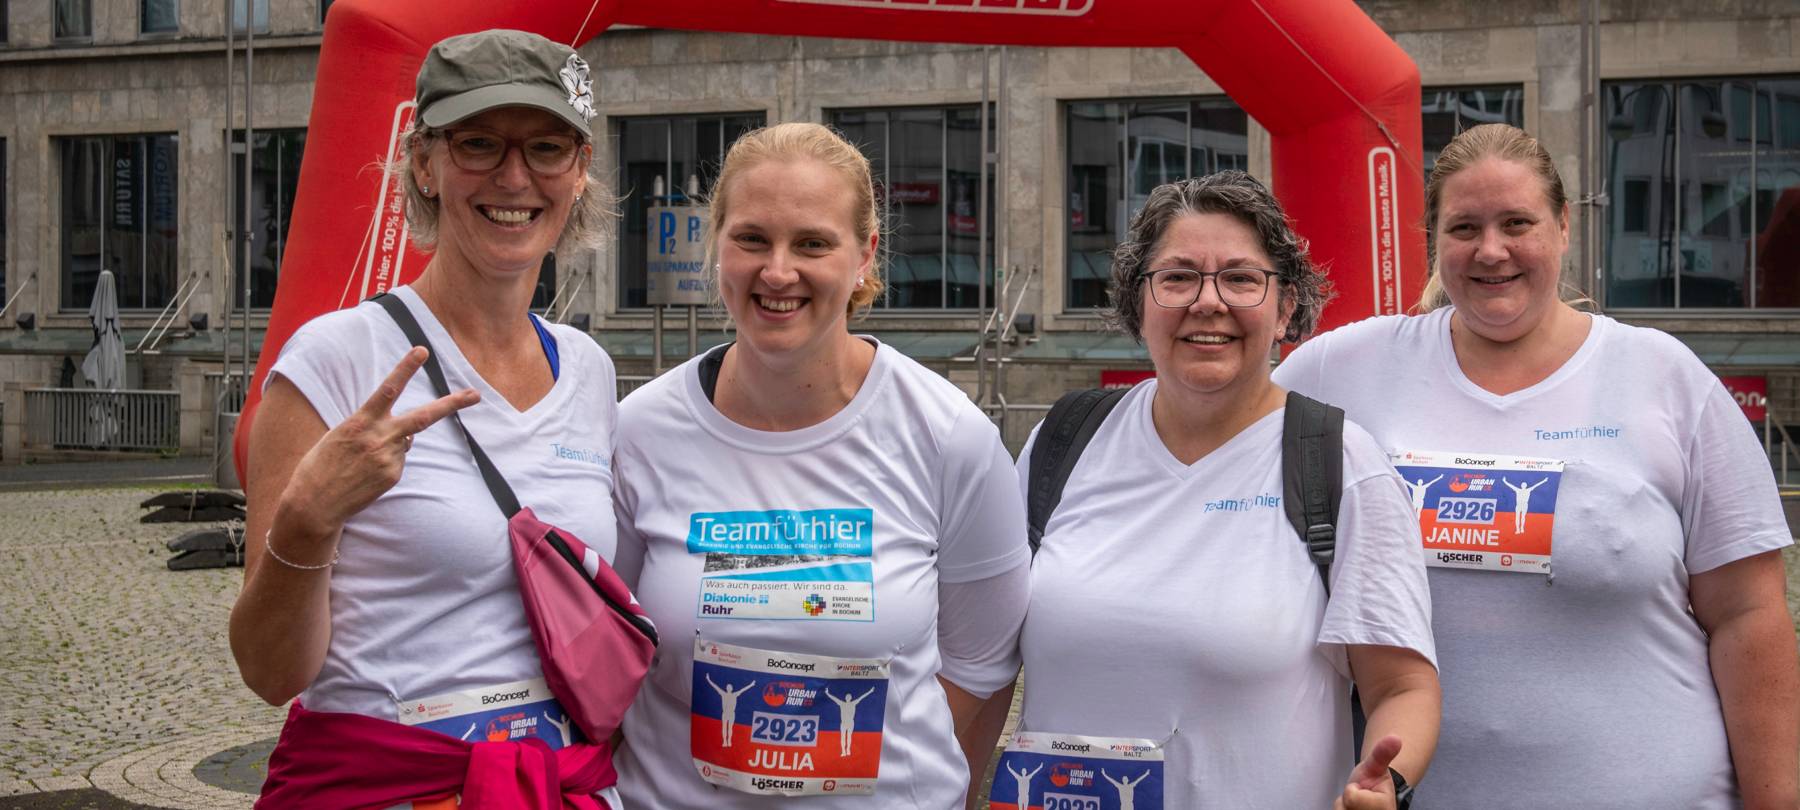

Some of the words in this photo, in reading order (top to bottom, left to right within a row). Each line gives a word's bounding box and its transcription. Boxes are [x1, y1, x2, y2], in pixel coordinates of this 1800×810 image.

[1379, 161, 1388, 197] Musik.
[389, 196, 402, 214] die
[1381, 198, 1390, 229] beste
[382, 215, 399, 252] 100%
[1381, 230, 1391, 247] die
[377, 254, 392, 281] hier.
[664, 261, 703, 272] SPARKASS
[1382, 249, 1392, 281] 100%
[677, 279, 706, 291] AUFZ
[1534, 426, 1620, 440] Teamfürhier
[1455, 457, 1495, 467] BoConcept
[1438, 501, 1494, 521] 2926
[695, 514, 867, 543] Teamfürhier
[1426, 527, 1500, 546] JANINE
[1437, 552, 1483, 563] LÖSCHER
[706, 580, 725, 590] Was
[727, 581, 748, 590] auch
[752, 582, 790, 592] passiert.
[793, 582, 809, 591] Wir
[810, 583, 831, 591] sind
[834, 583, 849, 591] da.
[703, 592, 757, 605] Diakonie
[702, 604, 734, 615] Ruhr
[767, 658, 816, 673] BoConcept
[842, 664, 880, 672] INTERSPORT
[482, 689, 530, 705] BoConcept
[788, 689, 816, 699] URBAN
[786, 697, 803, 707] RUN
[510, 716, 537, 730] URBAN
[752, 716, 816, 742] 2923
[510, 728, 527, 739] RUN
[1051, 740, 1090, 755] BoConcept
[1115, 744, 1152, 753] INTERSPORT
[748, 749, 815, 771] JULIA
[1070, 769, 1094, 779] URBAN
[752, 778, 804, 790] LÖSCHER
